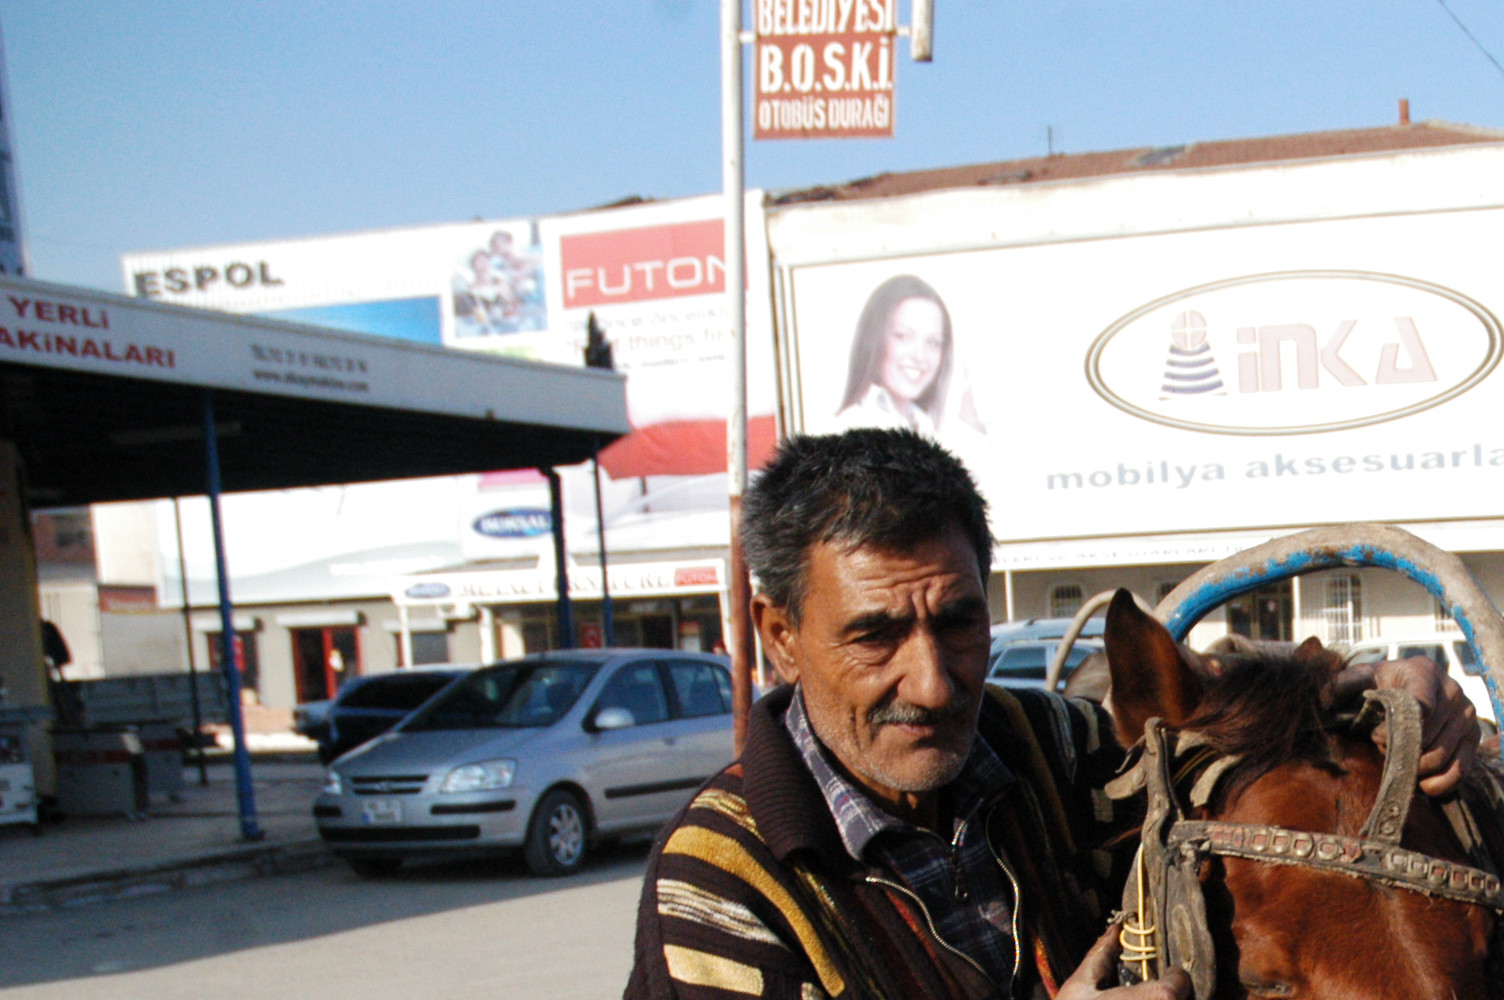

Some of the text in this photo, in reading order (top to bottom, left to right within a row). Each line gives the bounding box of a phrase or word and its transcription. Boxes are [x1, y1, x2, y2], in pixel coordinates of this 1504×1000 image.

[759, 96, 827, 130] OTOBÜS
[134, 261, 285, 298] ESPOL
[1046, 460, 1226, 490] mobilya
